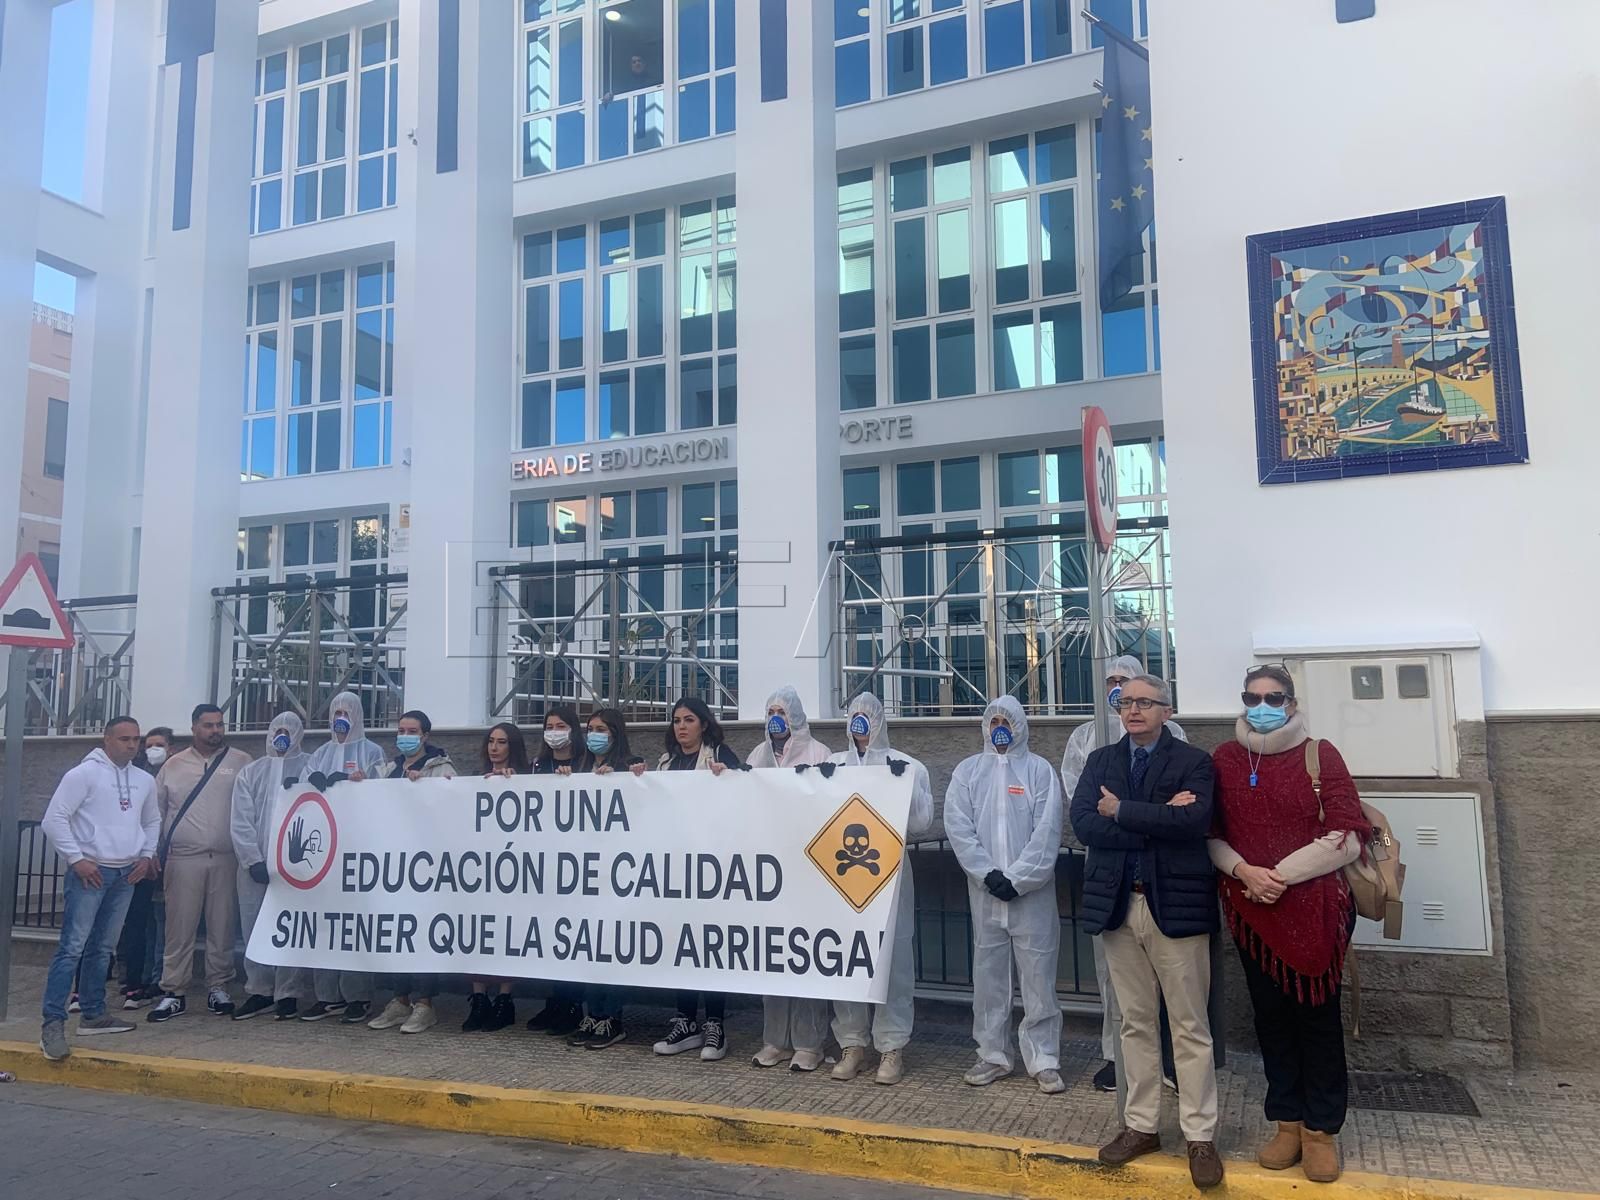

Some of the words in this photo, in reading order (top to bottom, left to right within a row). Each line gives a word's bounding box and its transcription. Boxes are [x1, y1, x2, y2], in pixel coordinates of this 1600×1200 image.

[511, 455, 560, 480] ERIA
[563, 452, 593, 474] DE
[1098, 446, 1115, 513] 30
[475, 791, 543, 833] POR
[554, 788, 631, 833] UNA
[342, 842, 545, 894] EDUCACIÓN
[557, 852, 600, 896] DE
[610, 852, 783, 902] CALIDAD
[271, 910, 318, 950] SIN
[323, 912, 418, 954] TENER
[427, 912, 496, 956] QUE
[505, 915, 544, 959] LA
[553, 917, 664, 966] SALUD
